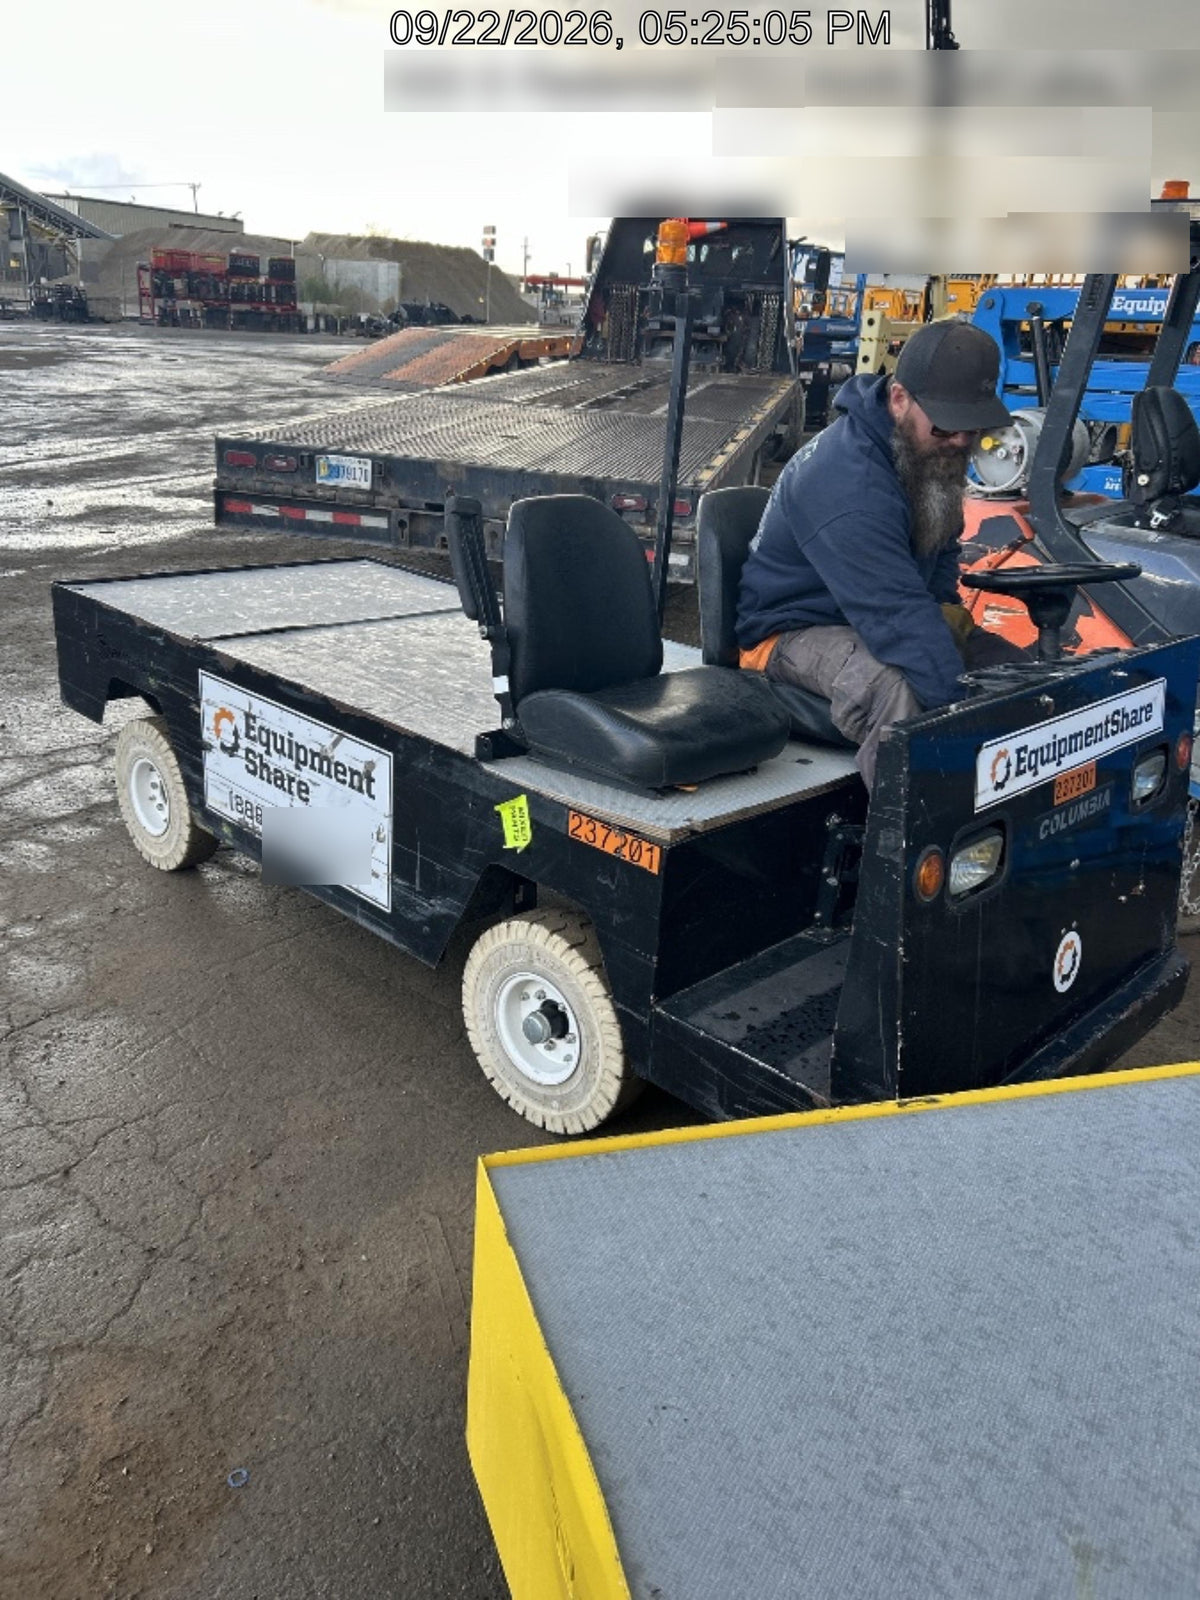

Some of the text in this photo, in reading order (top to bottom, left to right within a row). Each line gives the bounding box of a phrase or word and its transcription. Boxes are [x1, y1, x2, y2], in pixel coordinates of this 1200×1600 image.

[1111, 296, 1165, 315] Equip
[243, 710, 376, 801] Equipment
[1014, 702, 1153, 778] EquipmentShare
[244, 746, 310, 803] Share
[570, 813, 654, 870] 237201
[1039, 788, 1111, 840] COLUMBIA
